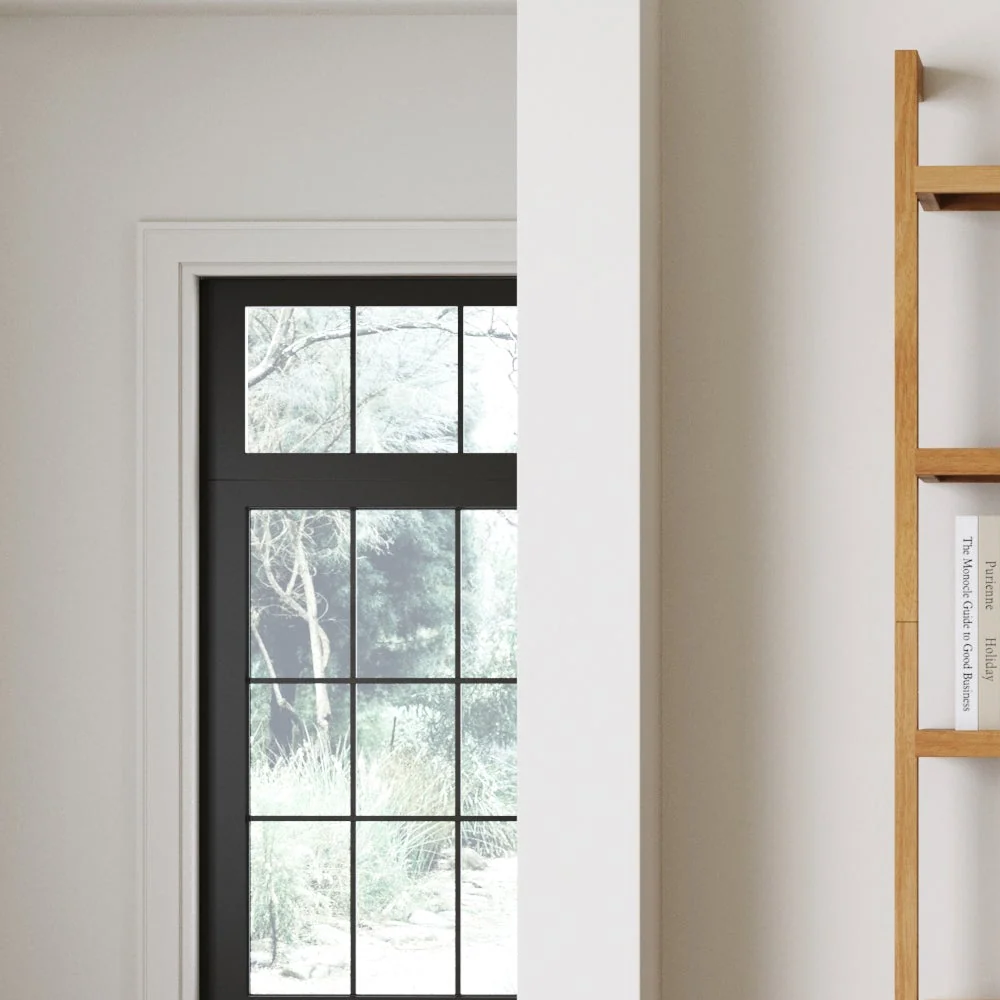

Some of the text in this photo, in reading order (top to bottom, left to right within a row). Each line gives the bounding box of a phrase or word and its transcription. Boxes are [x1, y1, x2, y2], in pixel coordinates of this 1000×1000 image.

[962, 536, 974, 712] The Monocle Guide to Good Business
[981, 561, 998, 682] Purienne Holiday
